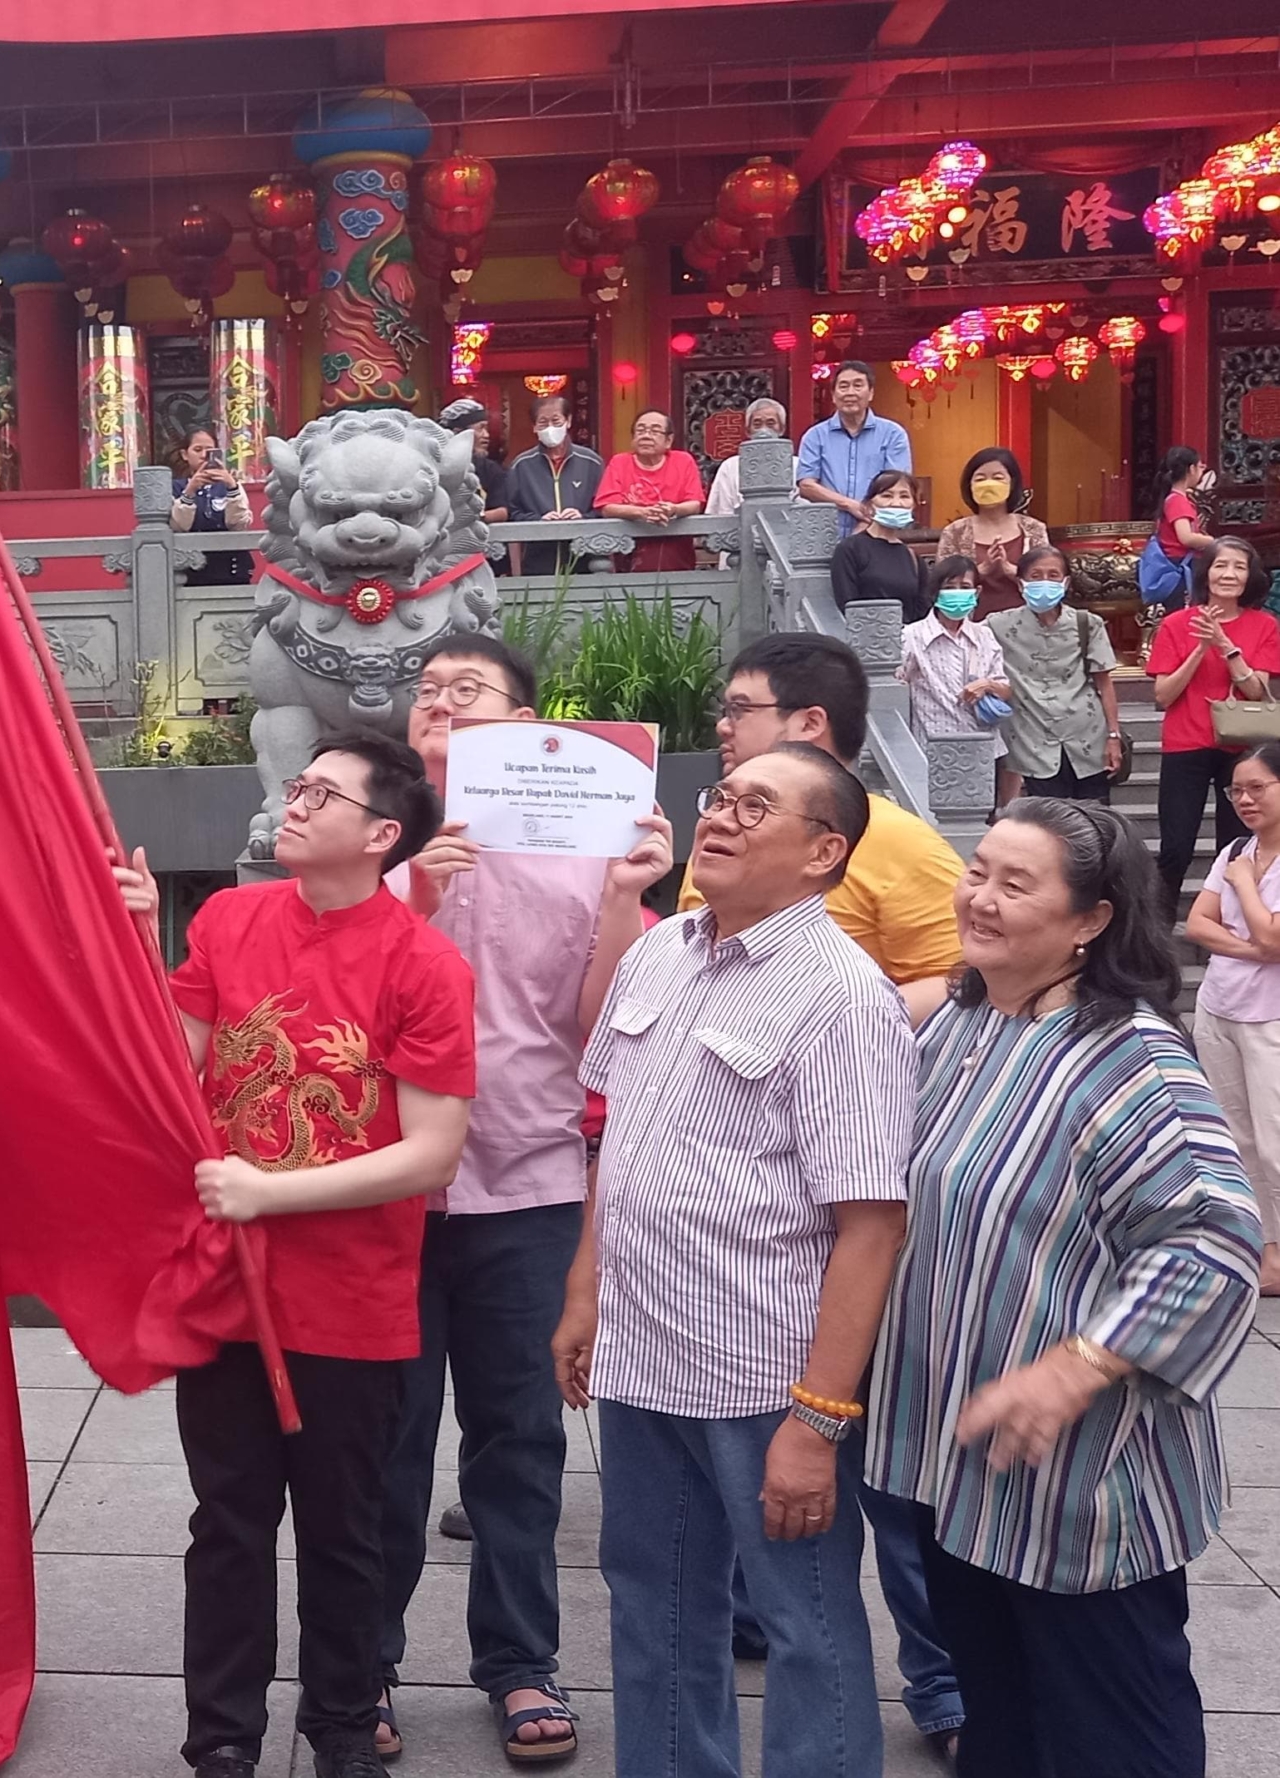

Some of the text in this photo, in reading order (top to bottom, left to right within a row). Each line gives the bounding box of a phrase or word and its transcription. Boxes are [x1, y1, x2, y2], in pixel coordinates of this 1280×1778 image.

[504, 762, 597, 775] Ucapan Terima Kasih
[464, 786, 635, 804] Keluarga Besar Bapak David Herman Jaya
